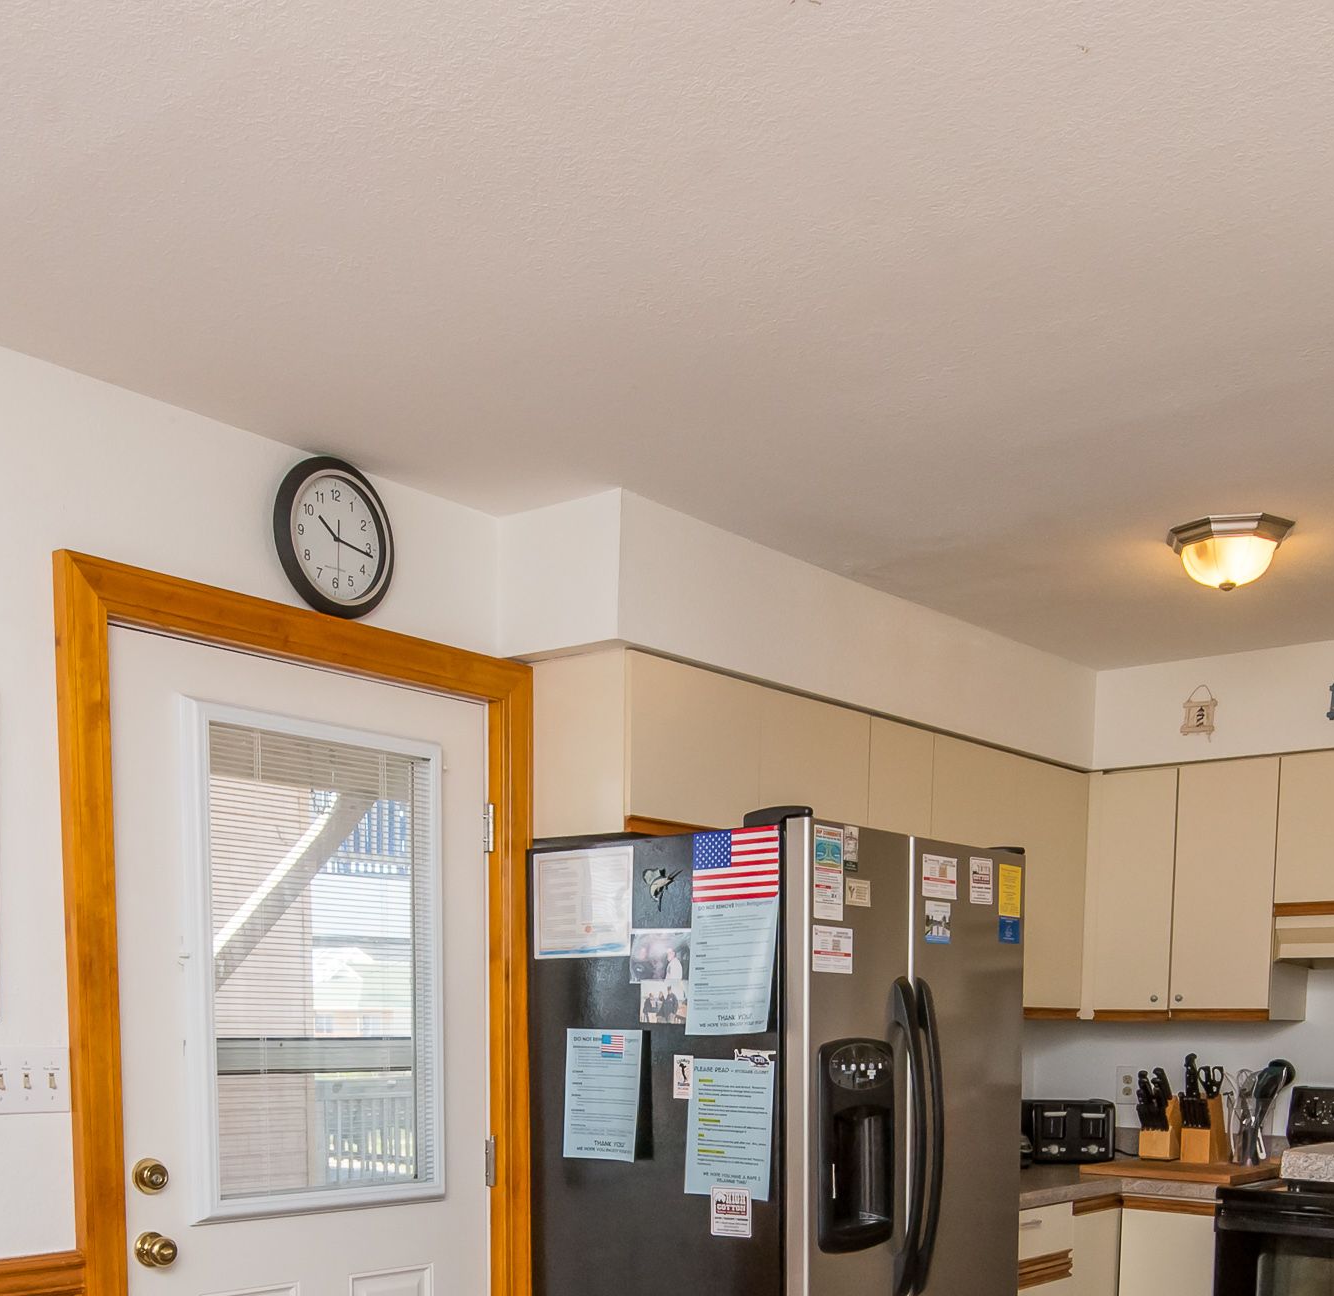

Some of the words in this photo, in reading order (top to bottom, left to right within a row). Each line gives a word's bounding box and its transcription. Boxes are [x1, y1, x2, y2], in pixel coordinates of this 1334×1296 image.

[315, 491, 324, 504] 11
[331, 489, 341, 502] 12
[303, 503, 314, 516] 10
[349, 501, 354, 513] 1
[298, 523, 305, 535] 9
[360, 519, 367, 532] 2
[304, 549, 311, 561] 8
[365, 543, 372, 555] 3
[316, 567, 323, 579] 7
[359, 564, 366, 575] 4
[332, 577, 339, 589] 6
[347, 575, 354, 587] 5
[693, 1065, 713, 1073] PLEASE
[716, 1203, 746, 1212] COTTON
